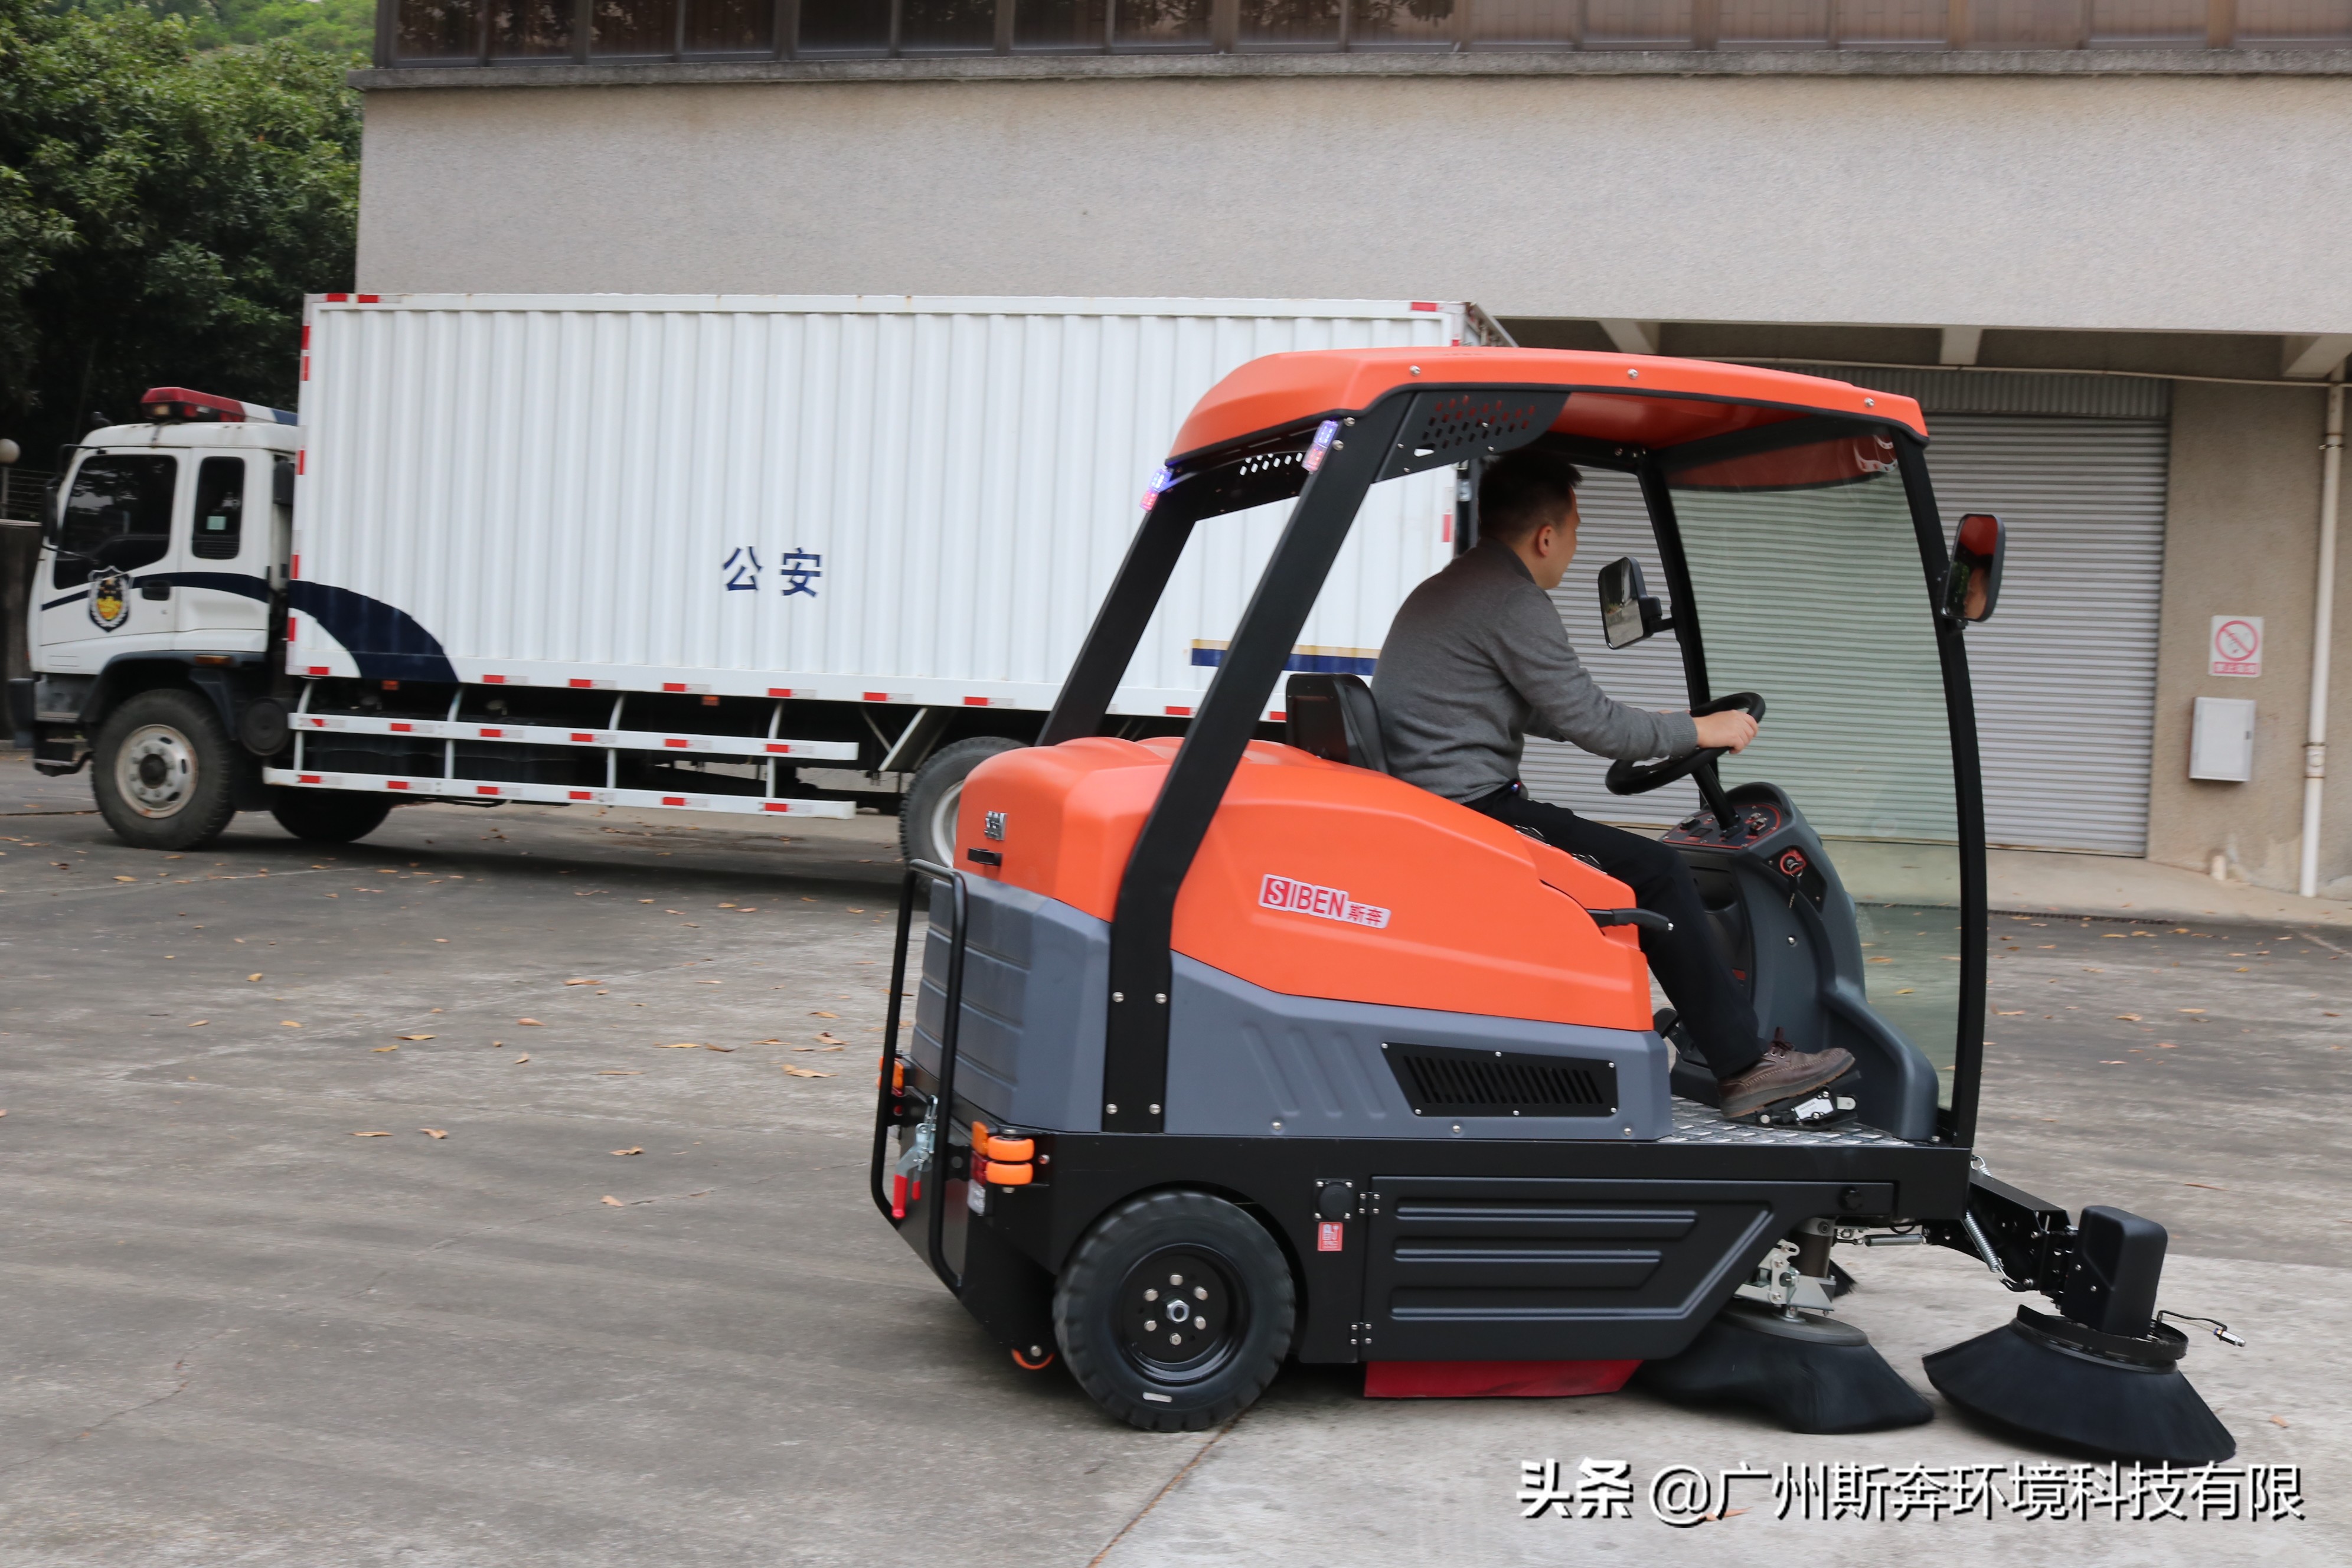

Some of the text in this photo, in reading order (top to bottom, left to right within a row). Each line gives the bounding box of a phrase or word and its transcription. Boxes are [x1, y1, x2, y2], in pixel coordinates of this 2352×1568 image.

[722, 545, 822, 597] 公安
[1262, 877, 1384, 926] SIBEN 斯奔
